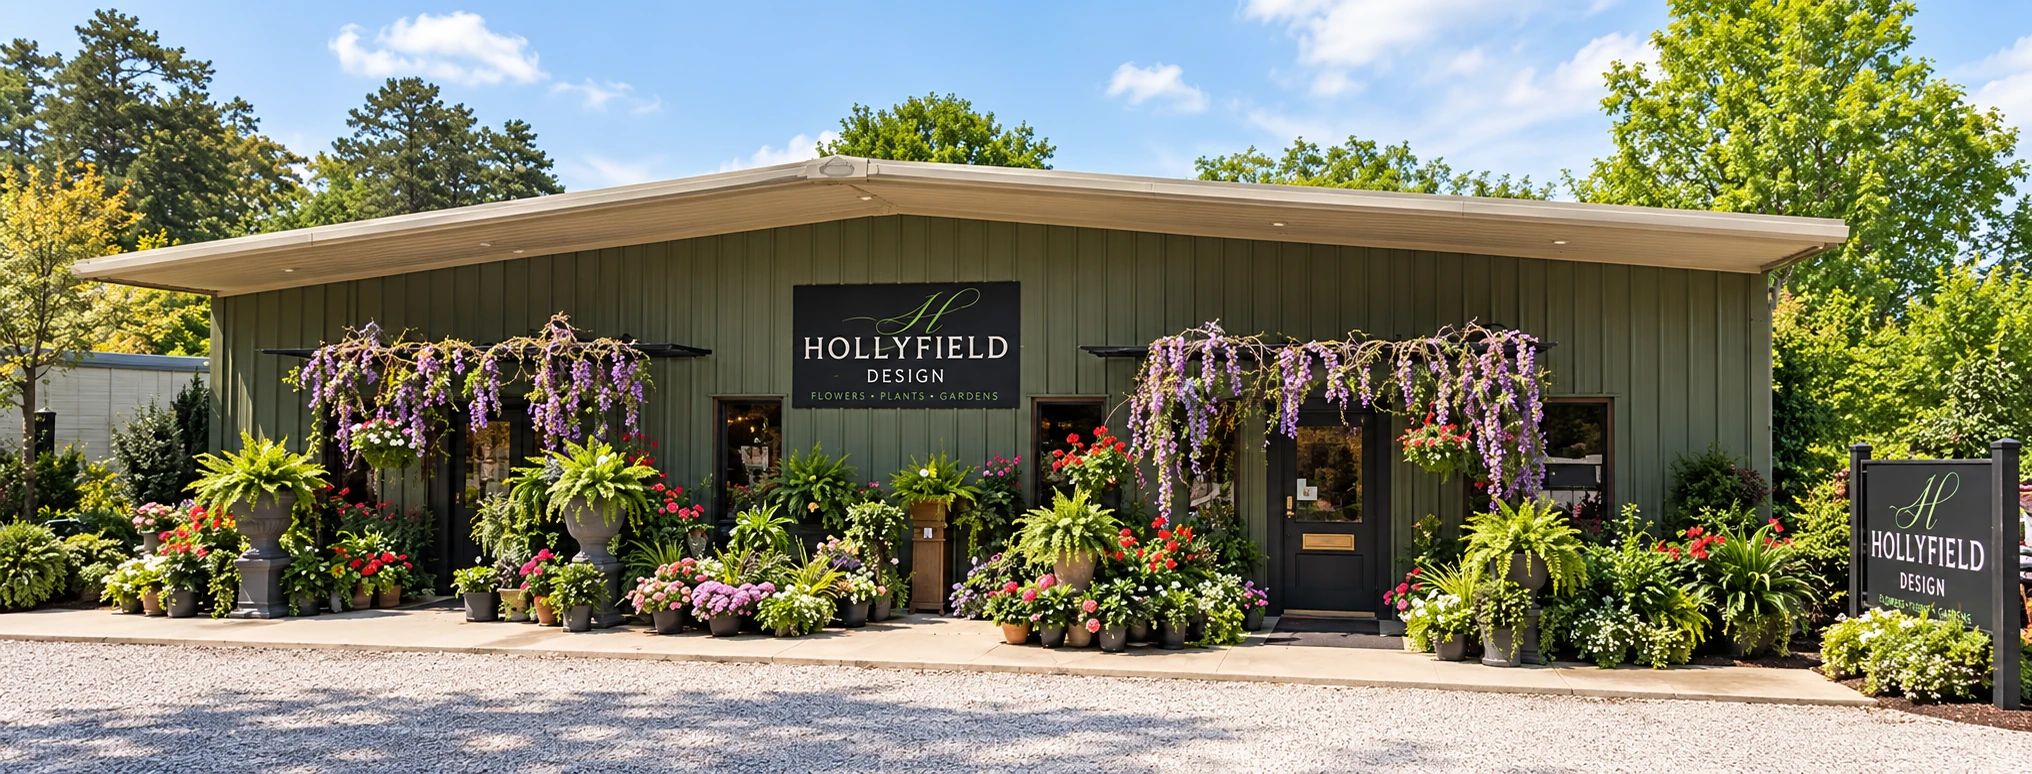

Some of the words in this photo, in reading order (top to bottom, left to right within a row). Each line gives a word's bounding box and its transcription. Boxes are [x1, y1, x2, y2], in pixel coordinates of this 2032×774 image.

[842, 287, 981, 335] H
[803, 335, 1009, 360] HOLLYFIELD
[866, 368, 944, 383] DESIGN
[811, 391, 865, 401] FLOWERS
[880, 391, 925, 401] PLANTS
[939, 391, 998, 401] GARDENS
[1889, 471, 1960, 530] H
[1871, 530, 1985, 572] HOLLYFIELD
[1899, 571, 1945, 597] DESIGN
